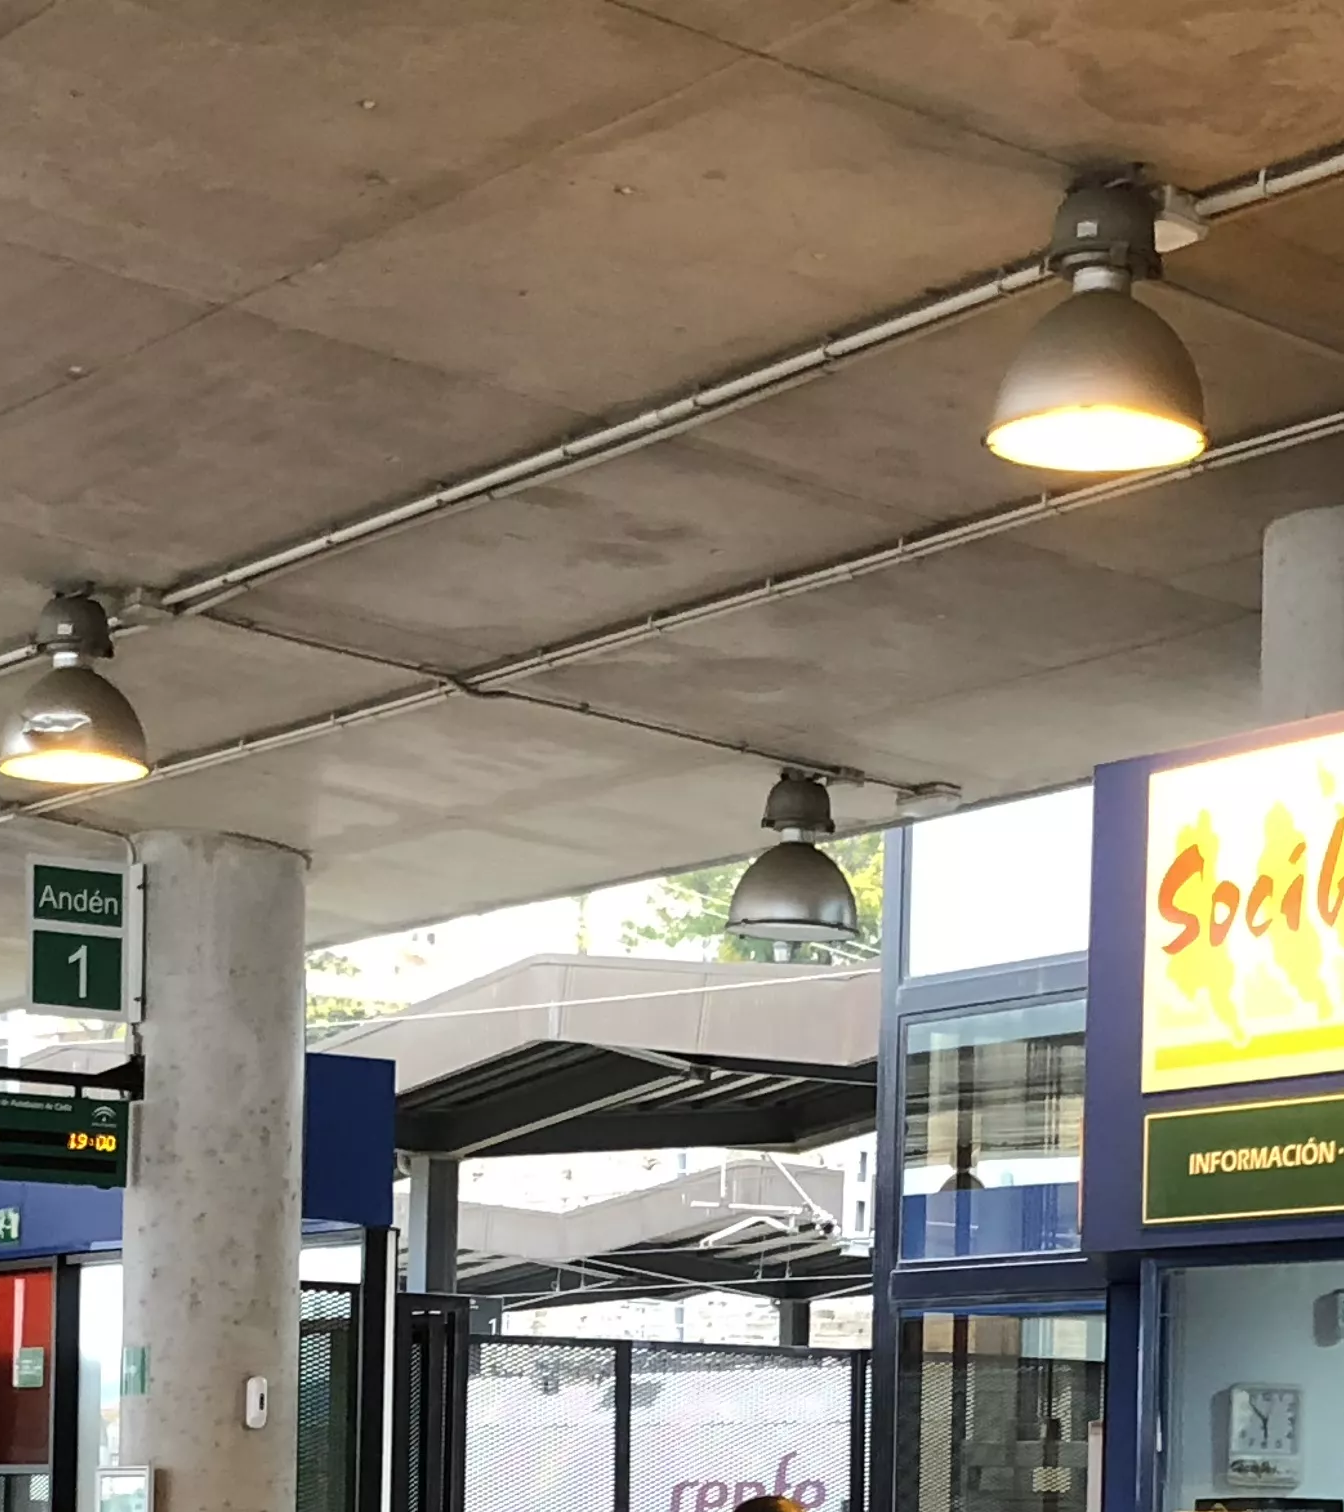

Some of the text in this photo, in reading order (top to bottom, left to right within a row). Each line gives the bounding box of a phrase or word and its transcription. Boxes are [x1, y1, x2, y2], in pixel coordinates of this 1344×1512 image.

[39, 884, 119, 915] Andén
[68, 944, 87, 999] 1
[67, 1133, 116, 1151] 19:00
[1189, 1137, 1336, 1175] INFORMACIÓN
